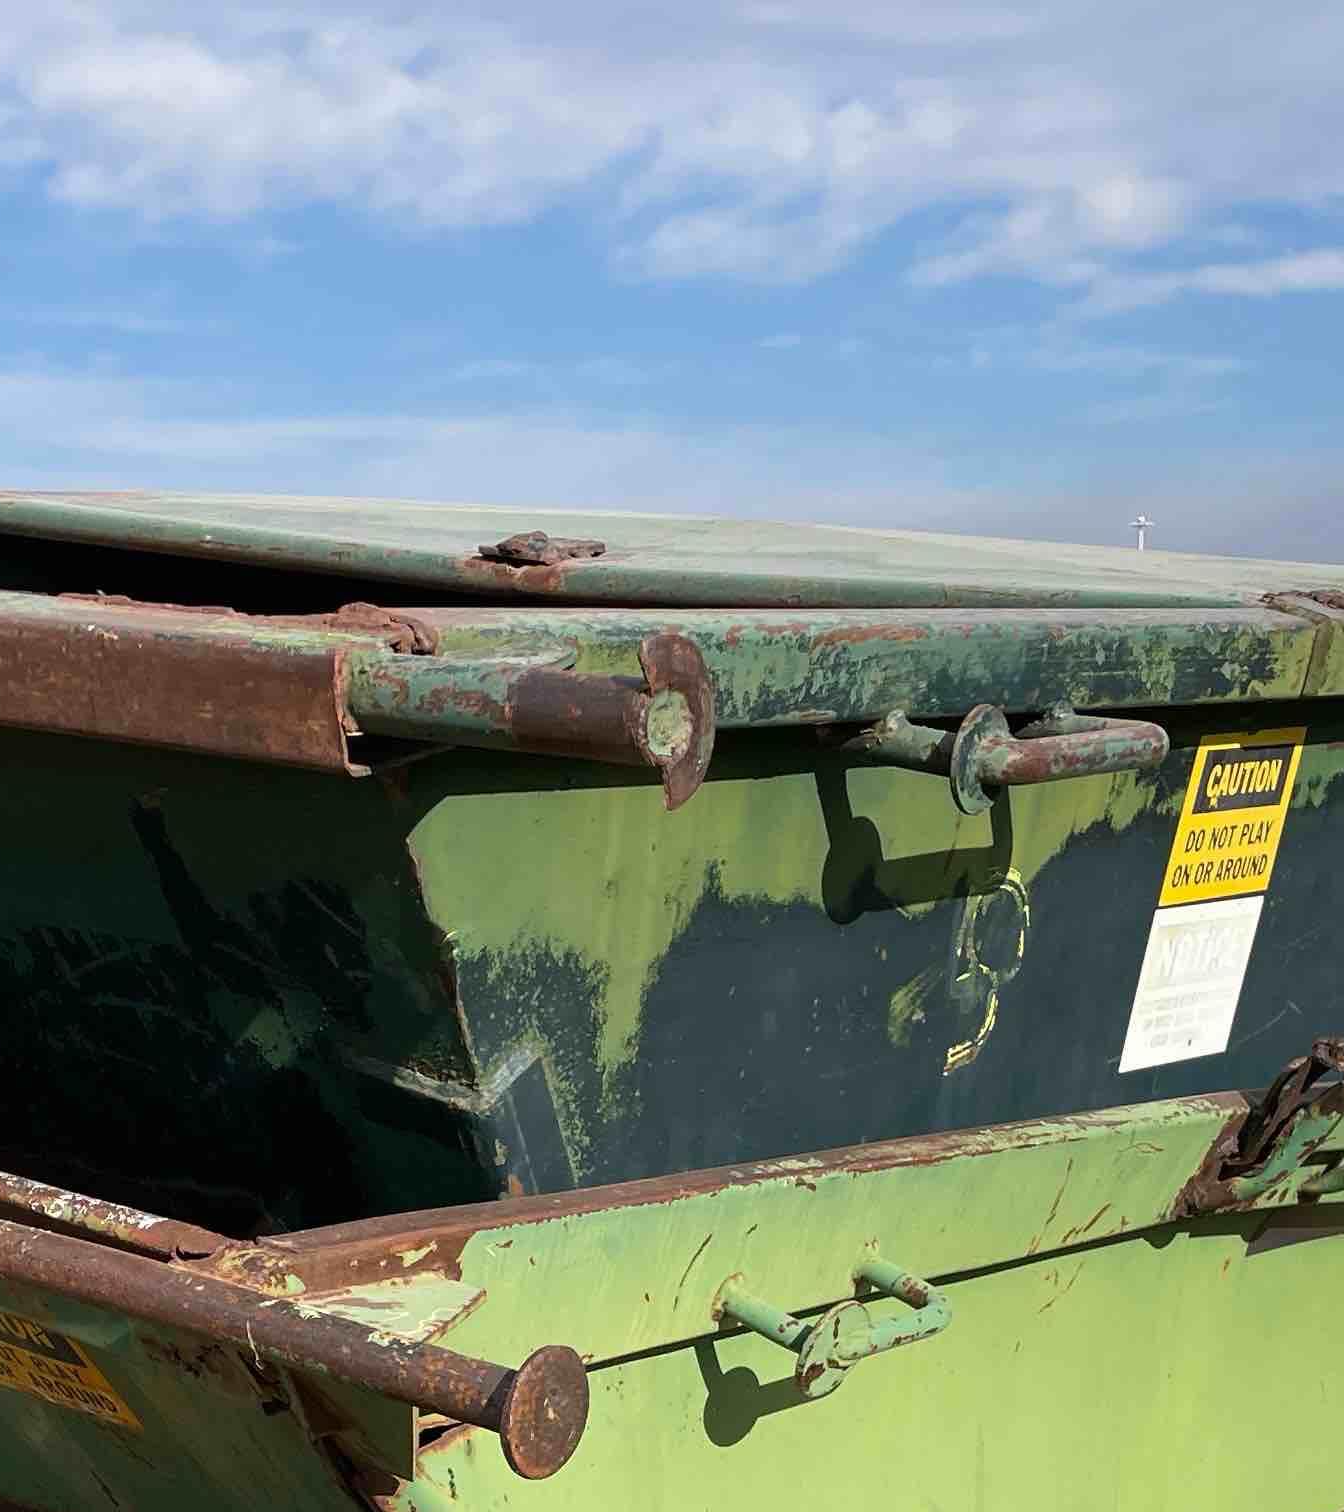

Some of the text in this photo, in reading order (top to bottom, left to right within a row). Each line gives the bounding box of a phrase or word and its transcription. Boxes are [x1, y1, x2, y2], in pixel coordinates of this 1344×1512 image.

[1207, 759, 1283, 799] CAUTION
[1184, 820, 1273, 853] DO NOT PLAY
[1172, 853, 1268, 888] ON OR AROUND
[26, 1371, 119, 1412] AROUND
